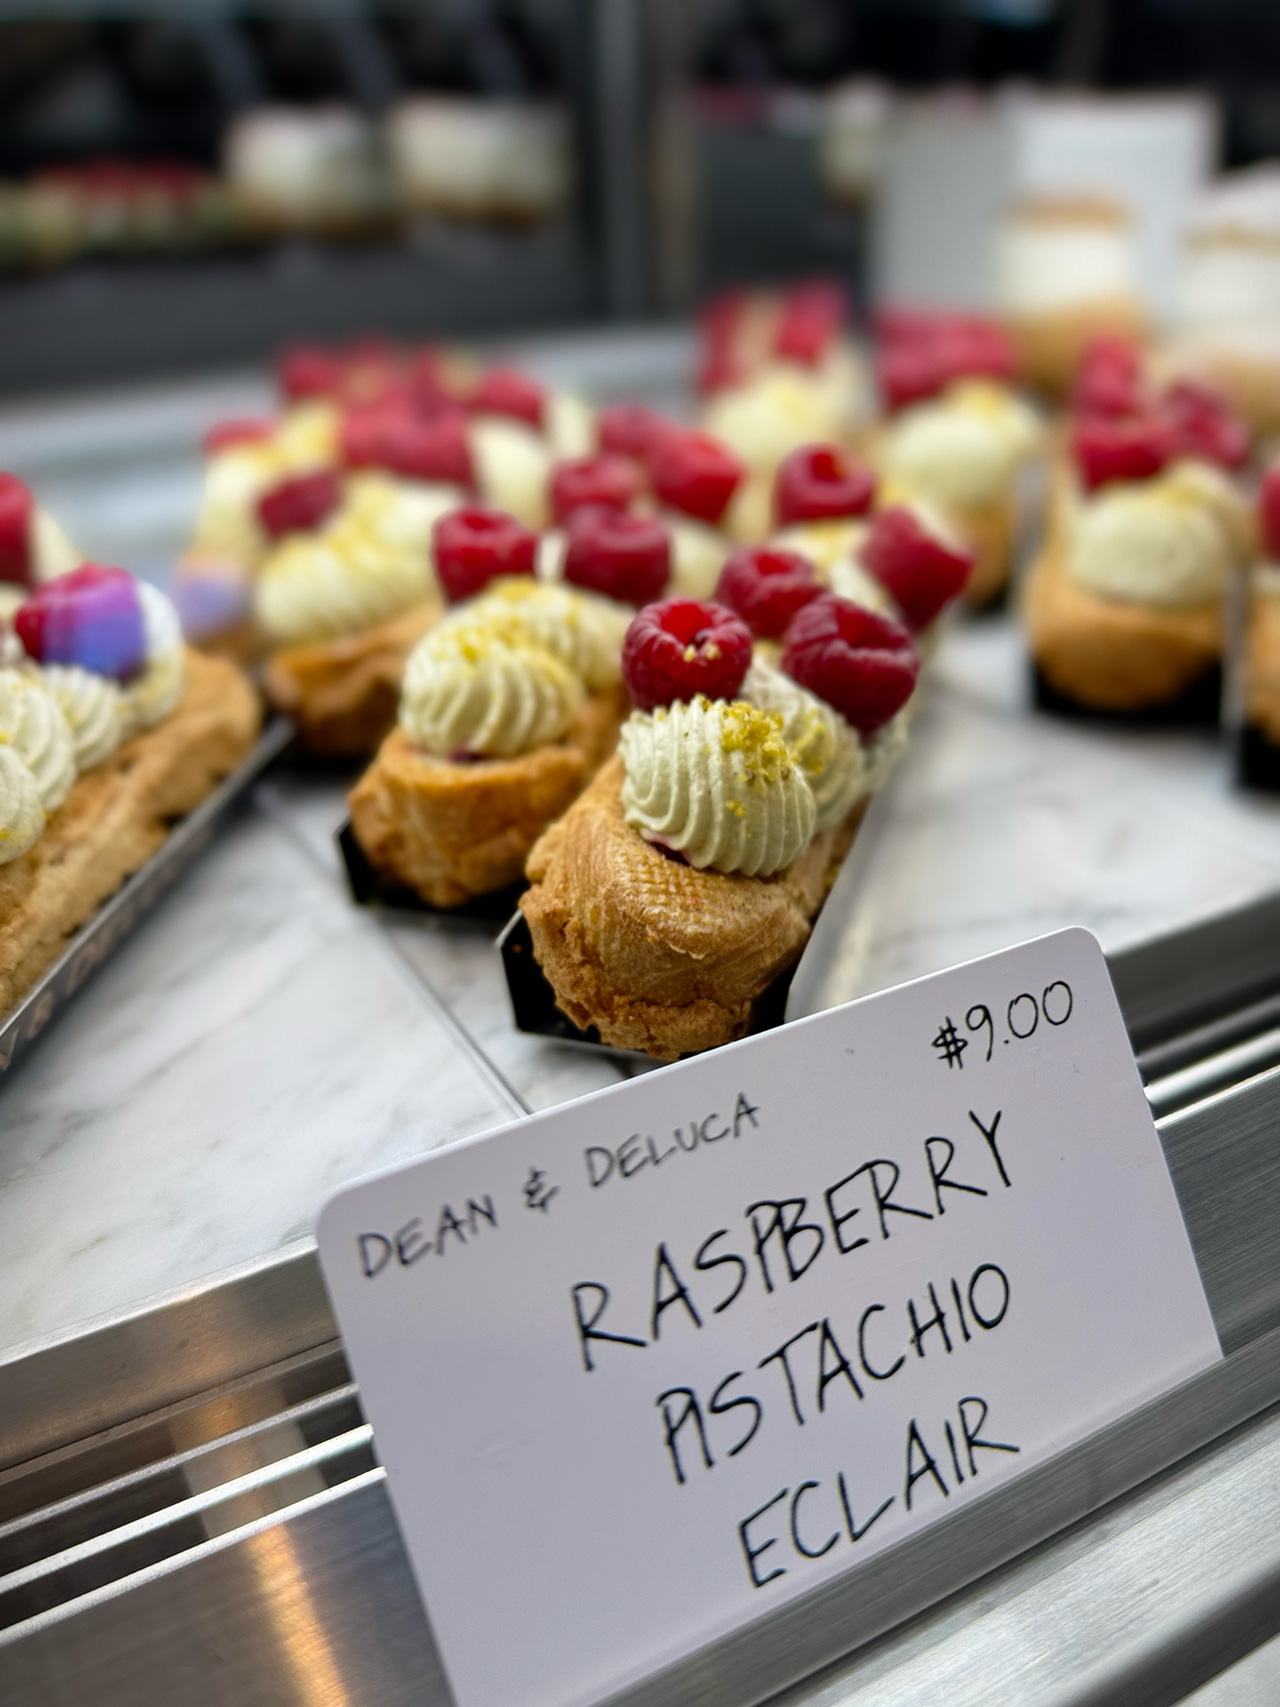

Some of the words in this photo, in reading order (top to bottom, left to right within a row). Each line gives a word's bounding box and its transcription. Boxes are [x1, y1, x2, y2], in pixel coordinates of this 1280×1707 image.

[932, 981, 1073, 1068] $9.00
[357, 1195, 497, 1278] DEAN
[523, 1167, 558, 1213] &
[585, 1092, 761, 1188] DELUCA
[571, 1110, 1012, 1371] RASPBERRY
[656, 1263, 1009, 1485] PISTACHIO
[738, 1396, 1020, 1587] ECLAIR
